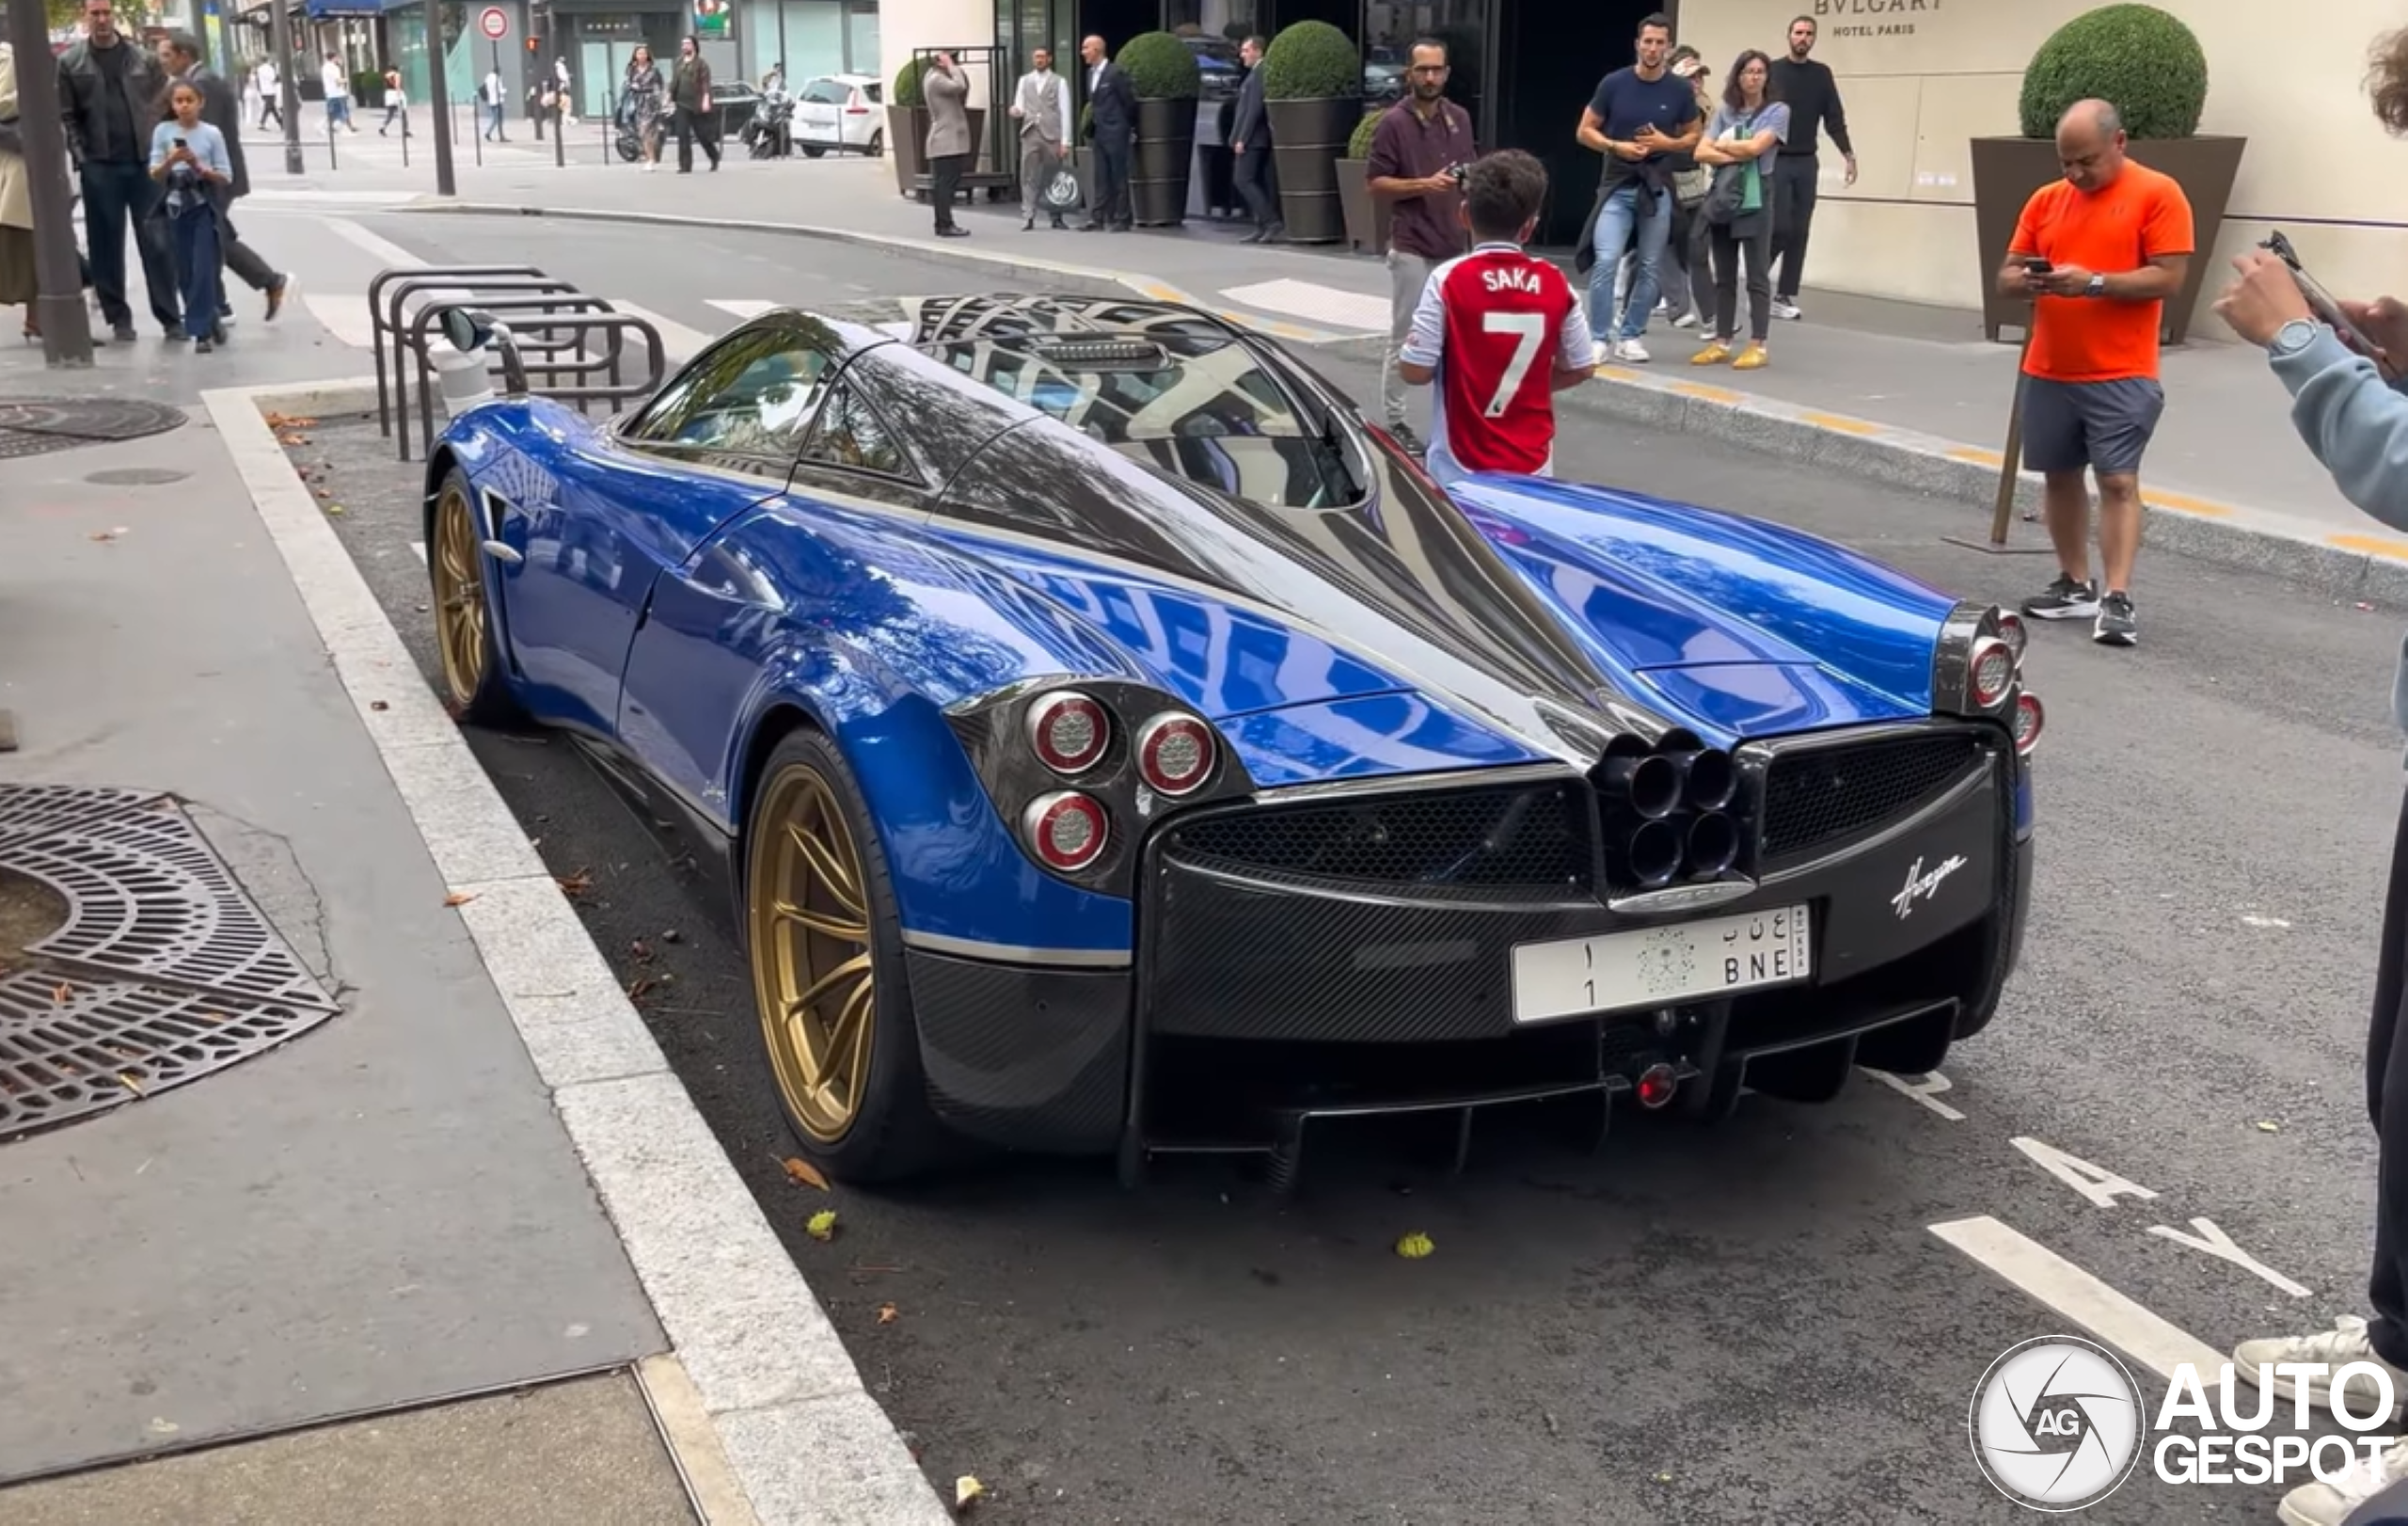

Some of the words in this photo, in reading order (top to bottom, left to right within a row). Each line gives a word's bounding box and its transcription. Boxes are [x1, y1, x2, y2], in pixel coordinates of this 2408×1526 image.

[1833, 26, 1873, 37] HOTEL
[1877, 24, 1915, 35] PARIS
[1481, 268, 1541, 294] SAKA
[1483, 312, 1545, 417] 7
[1584, 979, 1593, 1006] 1
[1725, 949, 1787, 984] BNE
